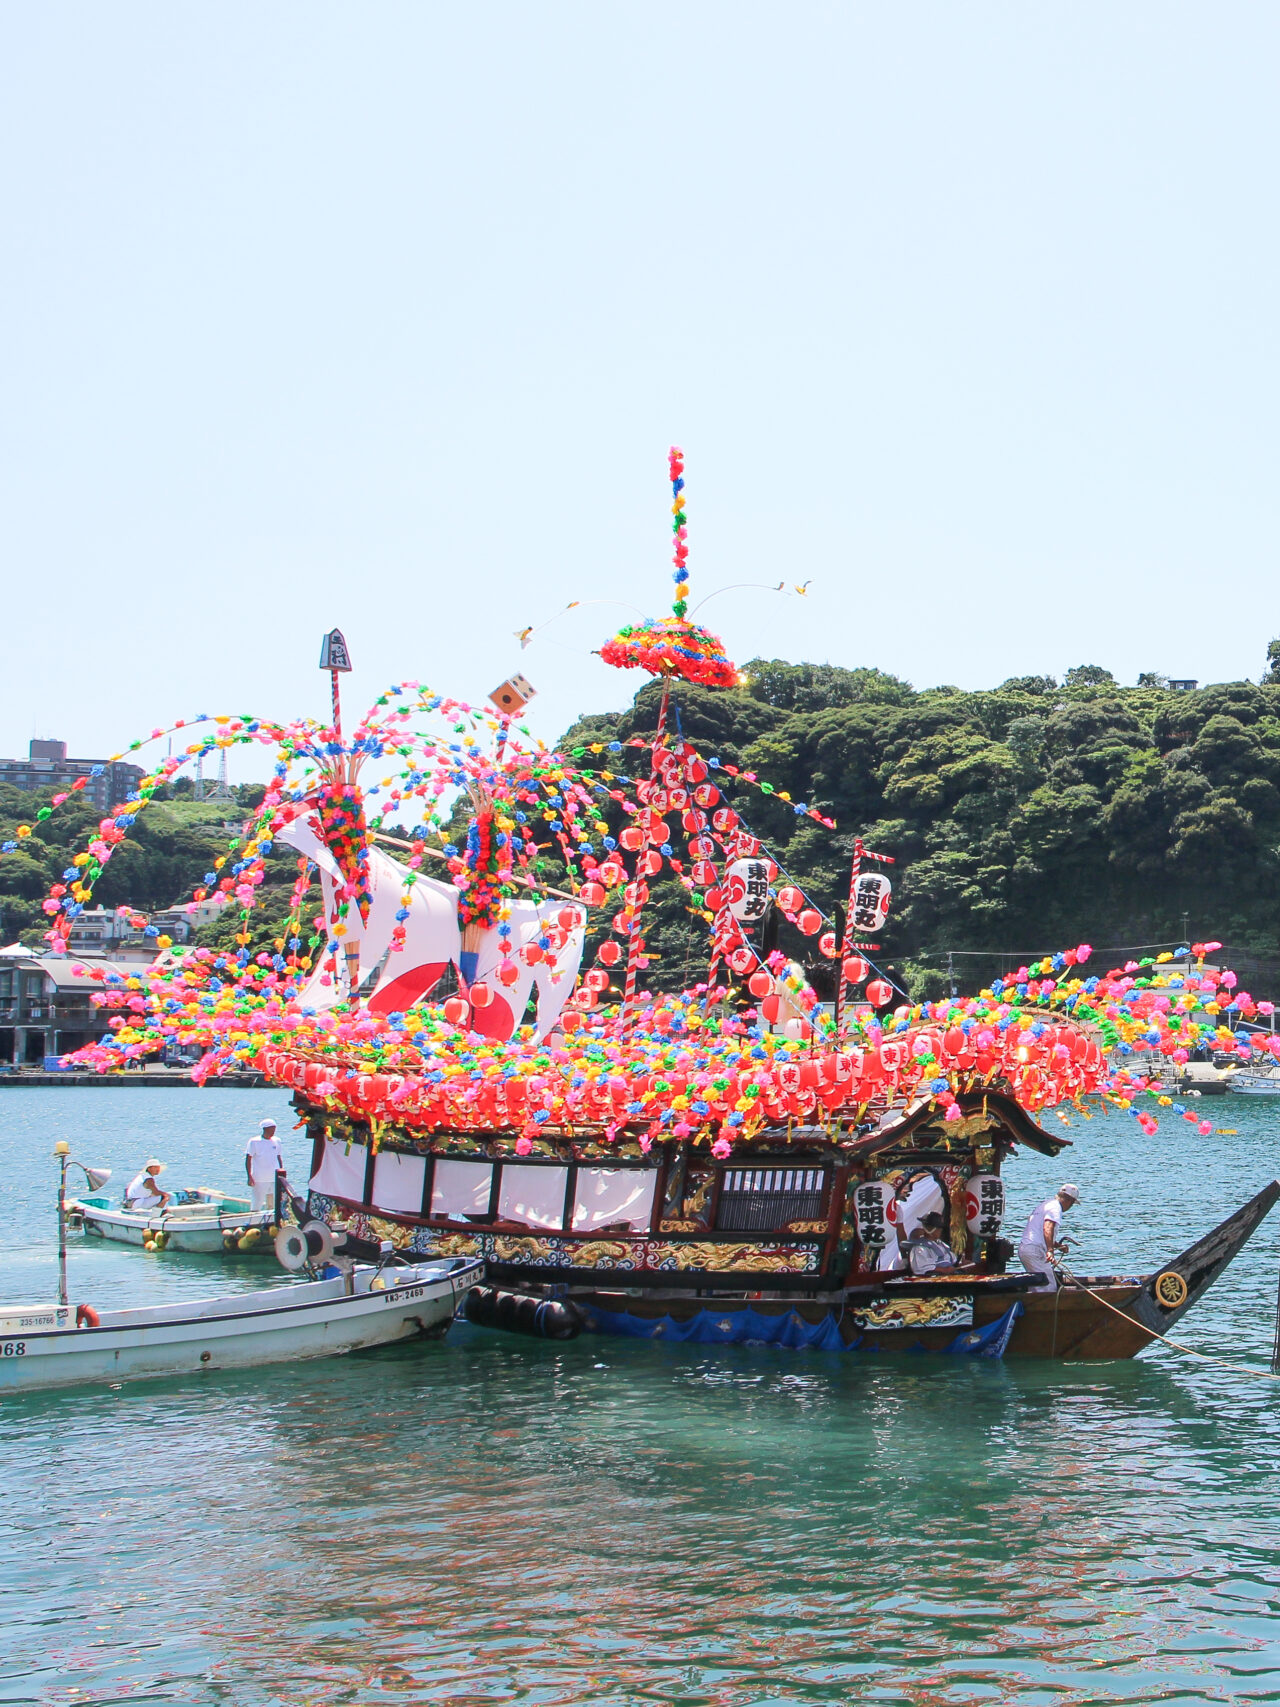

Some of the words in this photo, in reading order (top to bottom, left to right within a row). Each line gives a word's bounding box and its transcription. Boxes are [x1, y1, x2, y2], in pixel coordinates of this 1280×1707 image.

[744, 862, 767, 917] 東明丸
[855, 878, 882, 927] 東明丸
[823, 937, 836, 949] 東
[734, 951, 747, 963] 東
[588, 974, 601, 986] 東
[577, 991, 590, 1003] 東
[883, 1047, 899, 1064] 東
[839, 1058, 851, 1073] 東
[783, 1068, 798, 1084] 東
[858, 1185, 885, 1244] 東明丸
[979, 1179, 1003, 1235] 東明丸
[1161, 1276, 1182, 1302] 東
[0, 1342, 26, 1356] 68
